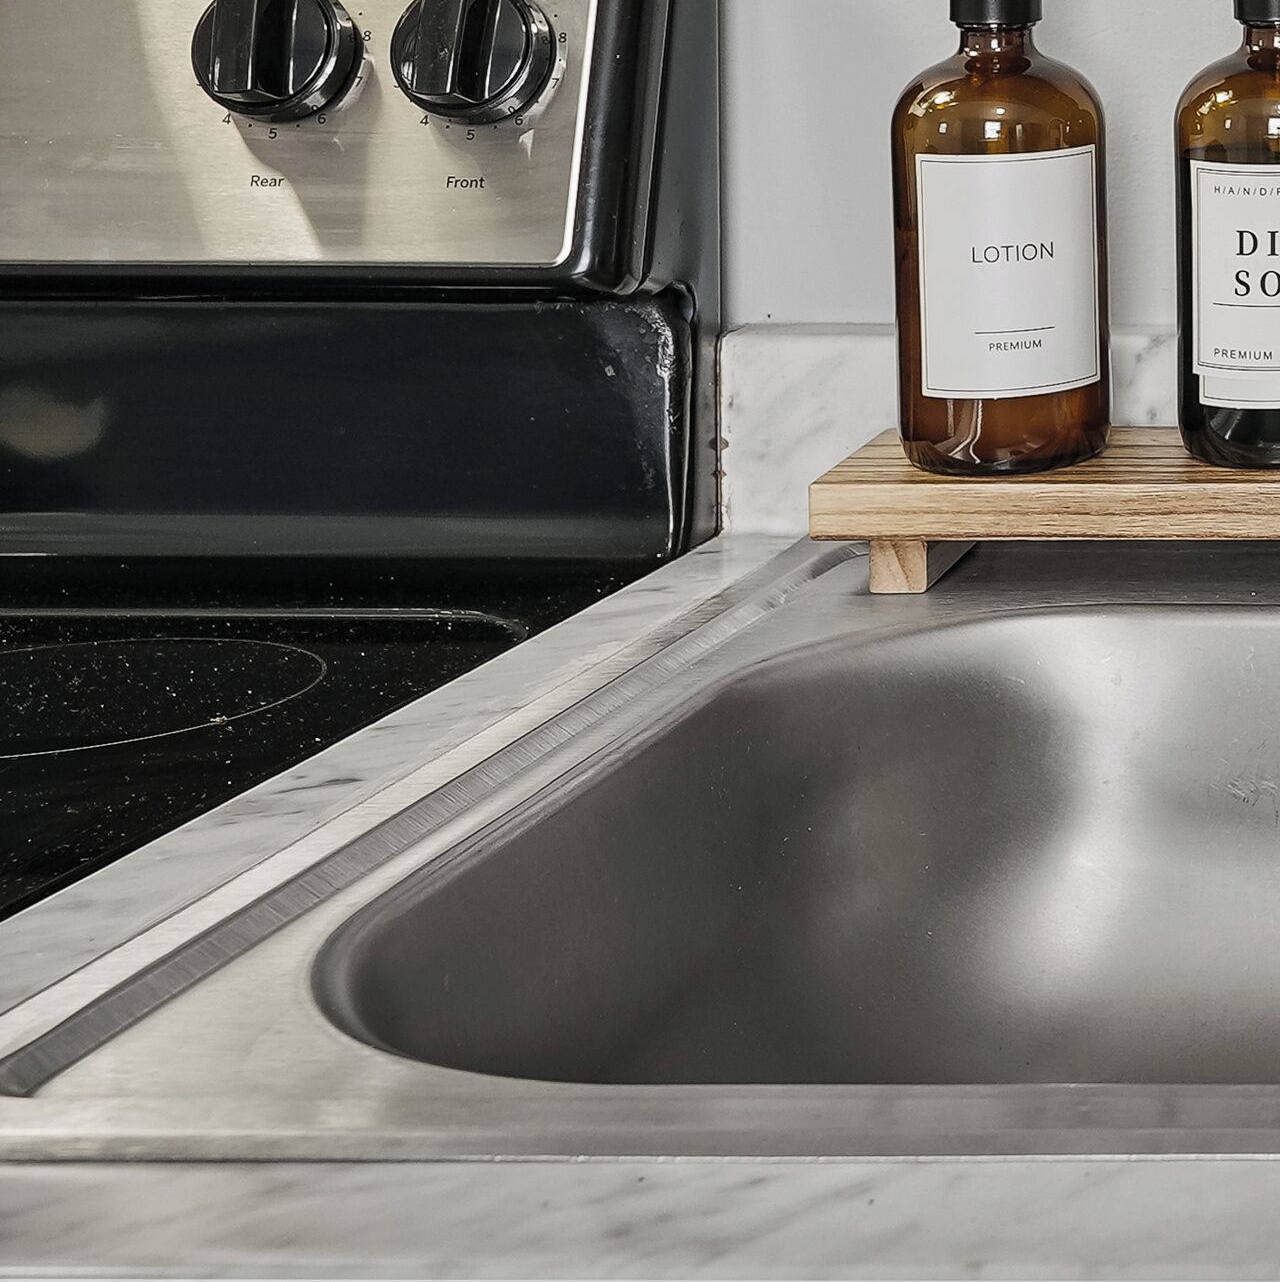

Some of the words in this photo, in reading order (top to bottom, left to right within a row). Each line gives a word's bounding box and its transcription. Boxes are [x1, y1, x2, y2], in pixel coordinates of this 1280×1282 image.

[362, 30, 372, 42] 8
[558, 32, 567, 43] 8
[551, 78, 560, 89] 7
[222, 113, 231, 125] 4
[318, 113, 326, 125] 6
[420, 115, 429, 126] 4
[514, 114, 523, 126] 6
[268, 127, 278, 140] 5
[466, 129, 475, 141] 5
[250, 174, 285, 188] Rear
[446, 175, 485, 189] Front
[972, 242, 1054, 263] LOTION
[988, 339, 1042, 351] PREMIUM
[1213, 348, 1273, 360] PREMIUM
